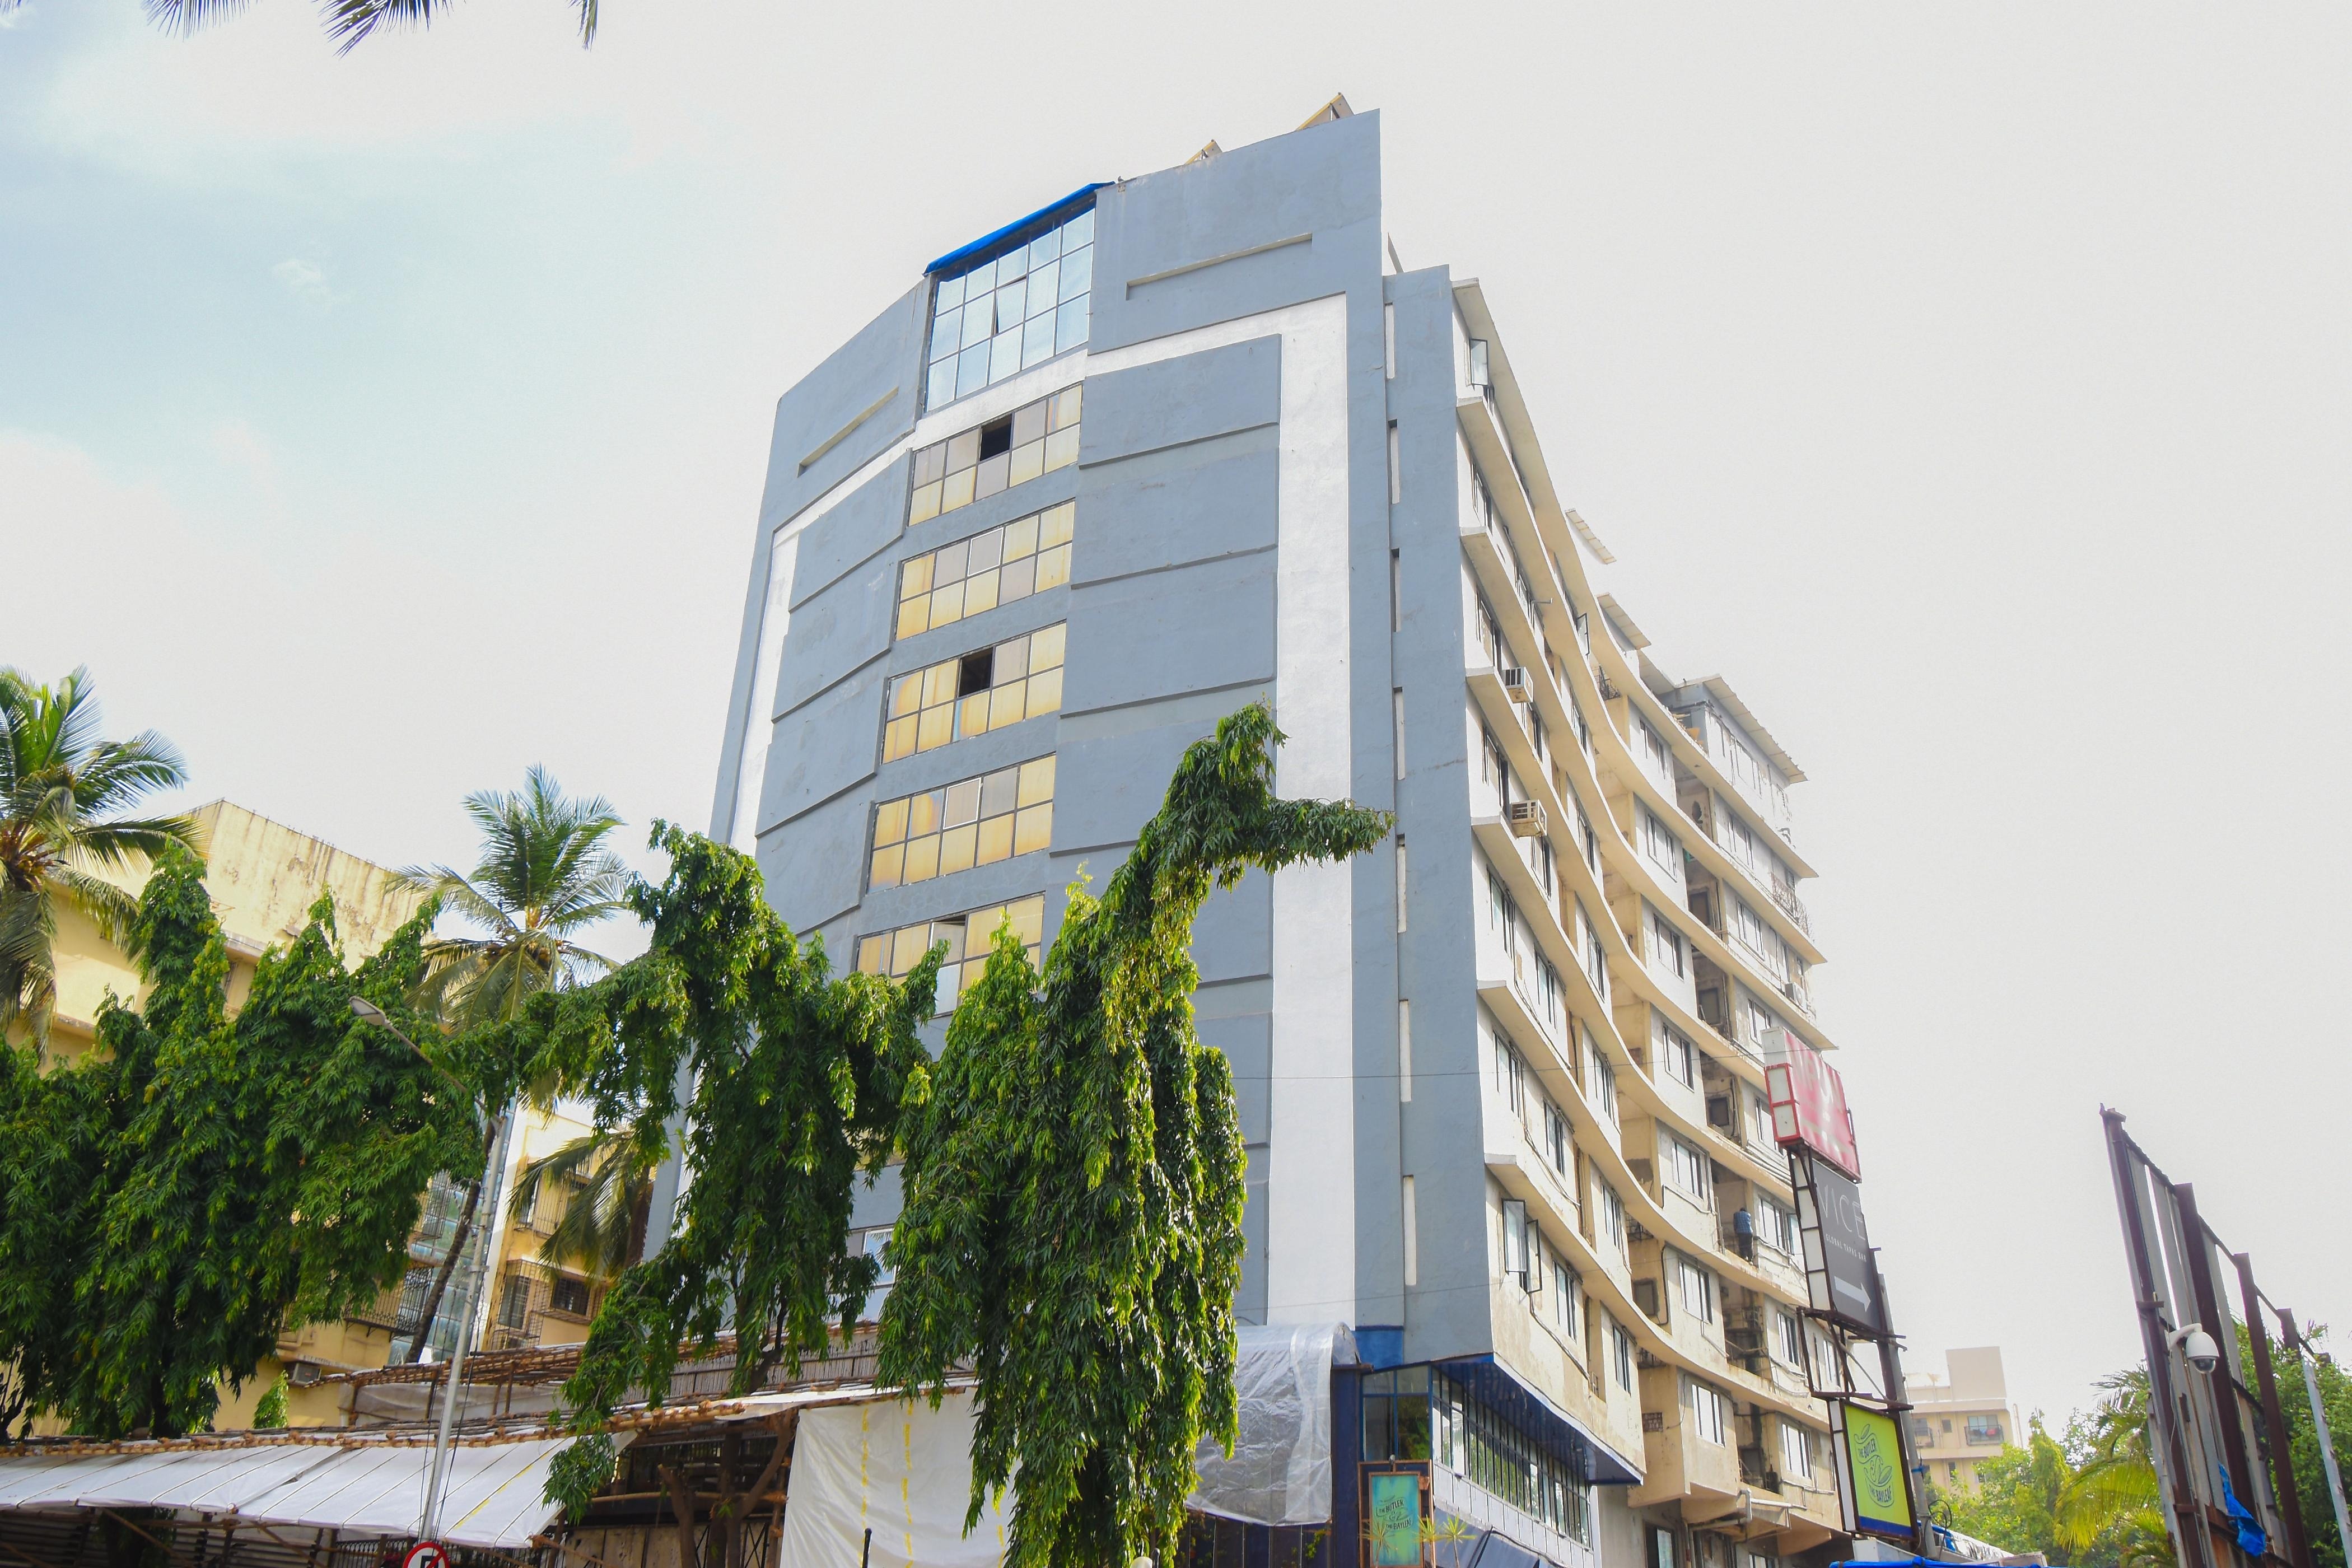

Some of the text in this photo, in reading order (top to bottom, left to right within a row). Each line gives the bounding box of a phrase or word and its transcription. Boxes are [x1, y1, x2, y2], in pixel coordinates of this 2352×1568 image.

[1814, 1178, 1865, 1240] VICE
[1825, 1233, 1842, 1249] GLOBAL
[1844, 1243, 1857, 1257] TAPAS
[1864, 1439, 1877, 1458] BUTLER
[1876, 1486, 1892, 1502] BAYLEAF
[1385, 1500, 1404, 1511] BUTLER
